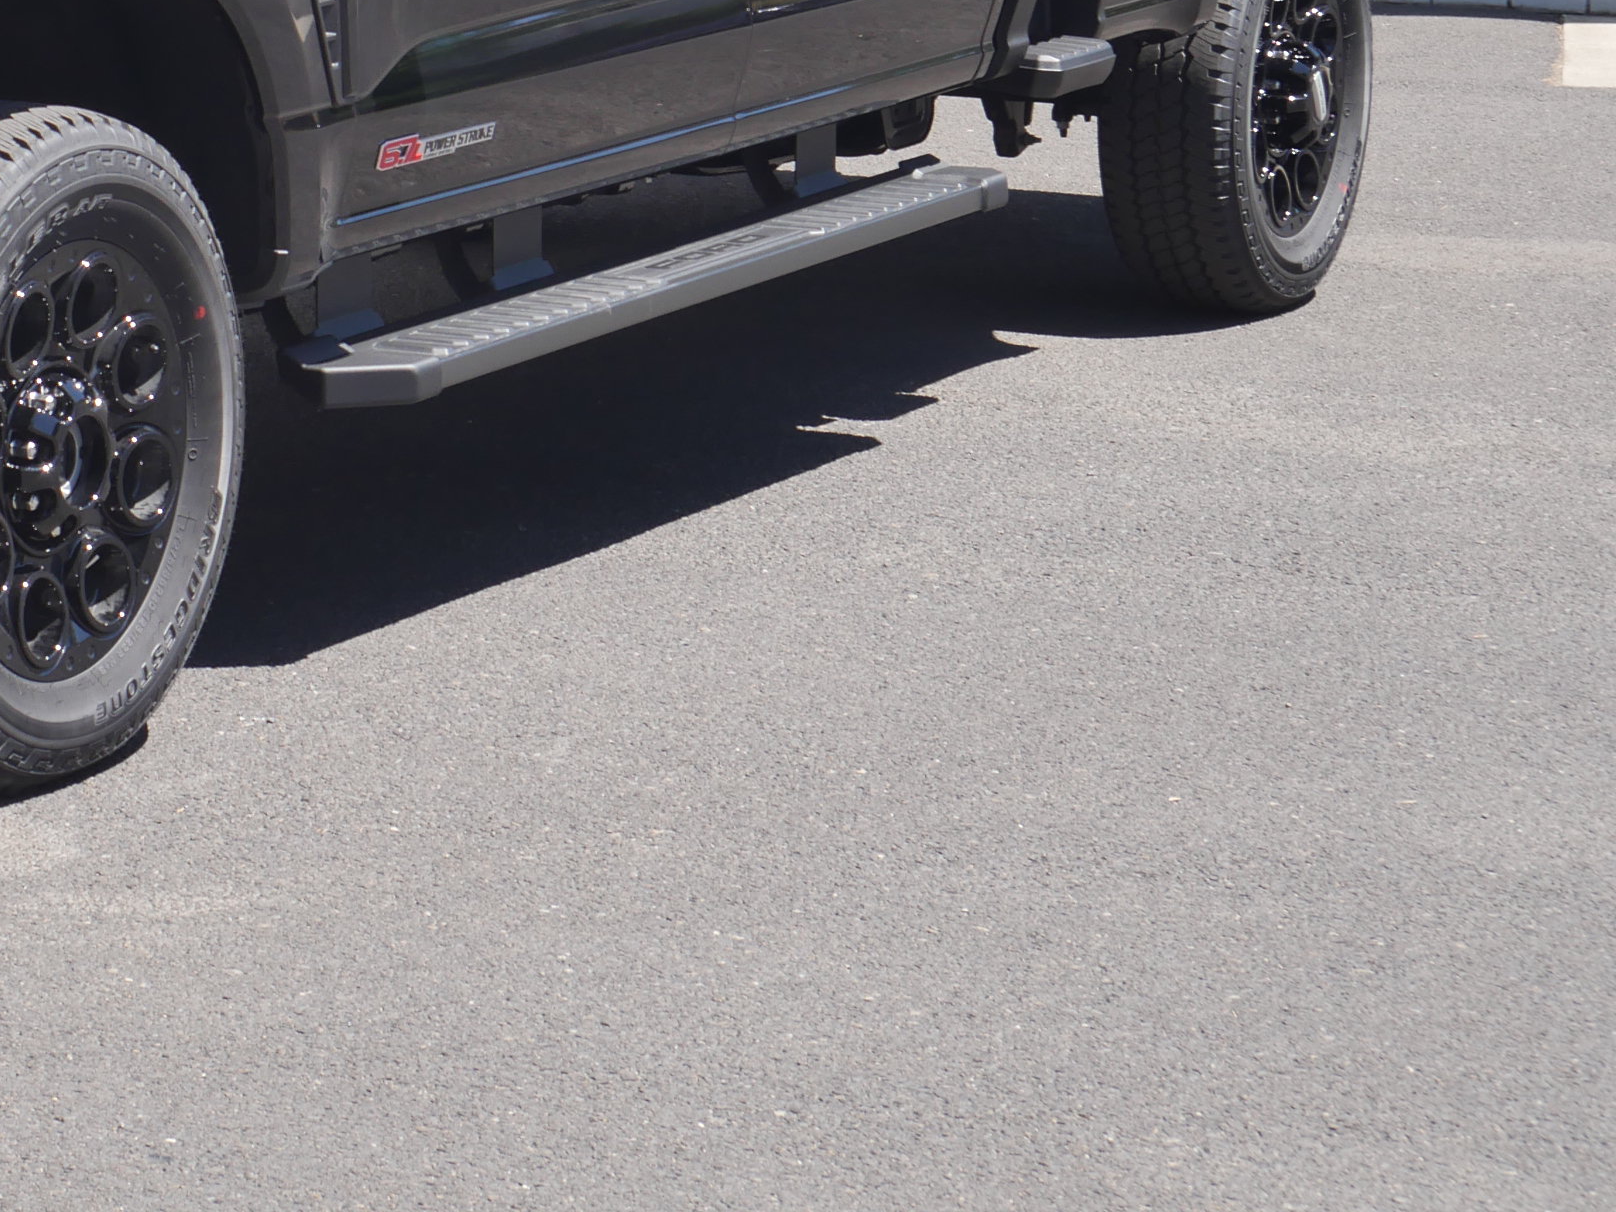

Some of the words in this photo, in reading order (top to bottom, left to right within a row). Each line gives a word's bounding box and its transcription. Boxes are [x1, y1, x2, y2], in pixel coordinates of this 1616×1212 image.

[424, 134, 457, 154] POWER
[457, 124, 494, 145] STROKE
[94, 487, 222, 726] BRIDGESTONE
